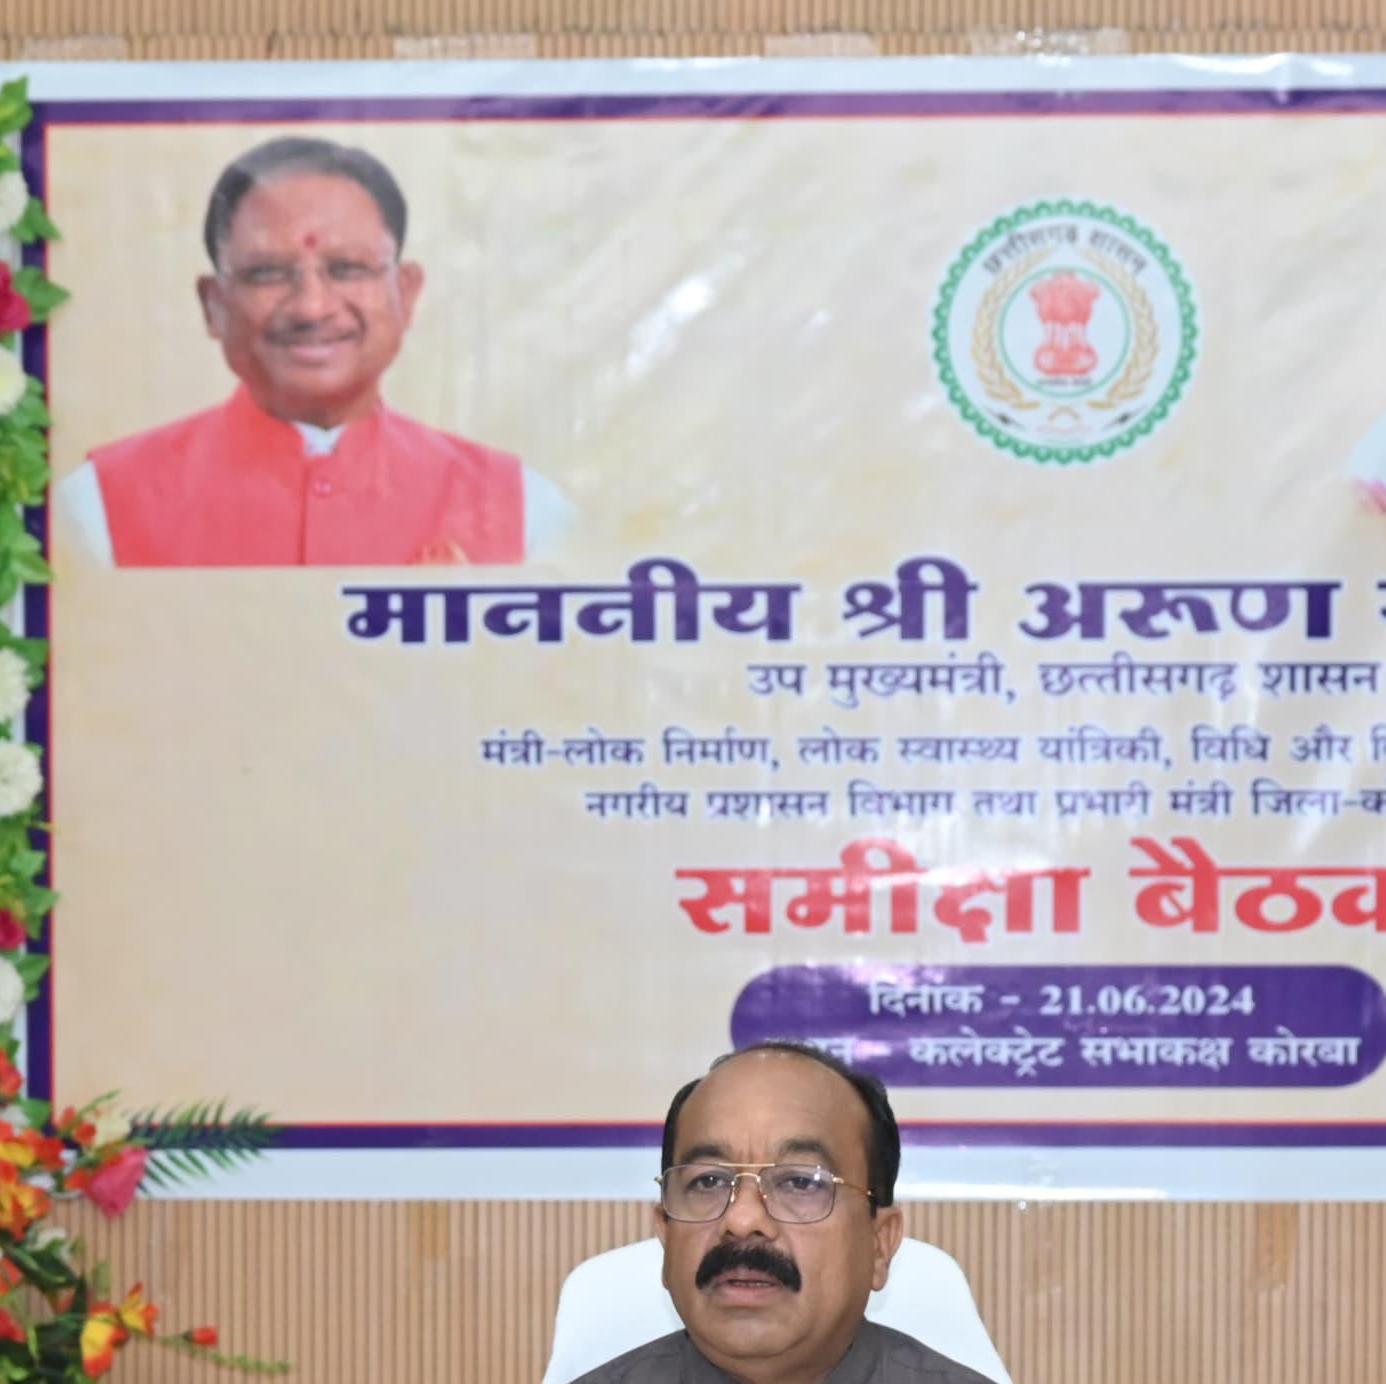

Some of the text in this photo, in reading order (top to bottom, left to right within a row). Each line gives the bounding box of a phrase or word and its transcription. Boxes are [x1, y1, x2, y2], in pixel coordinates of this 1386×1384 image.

[342, 558, 801, 643] माननीय
[843, 557, 979, 641] श्री
[1018, 580, 1341, 640] अरूण
[747, 663, 806, 695] उप
[827, 651, 1016, 709] मुख्यमंत्री,
[1258, 662, 1381, 694] शासन
[482, 728, 645, 765] मंत्री-लोक
[663, 726, 780, 771] निर्माण,
[798, 727, 880, 764] लोक
[898, 736, 1020, 764] स्वास्थ्य
[1039, 725, 1172, 770] यांत्रिकी,
[1191, 724, 1270, 763] विधि
[1290, 724, 1352, 763] और
[585, 781, 689, 817] नगरीय
[849, 779, 953, 817] विभाग
[973, 789, 1037, 817] तथा
[1056, 780, 1152, 817] प्रभारी
[1170, 780, 1233, 817] मंत्री
[675, 838, 1091, 943] समीक्षा
[868, 977, 985, 1017] दिनांक
[1039, 985, 1255, 1016] 21.06.2024
[909, 1026, 1065, 1076] कलेक्ट्रेट
[1247, 1025, 1362, 1068] कोरबा
